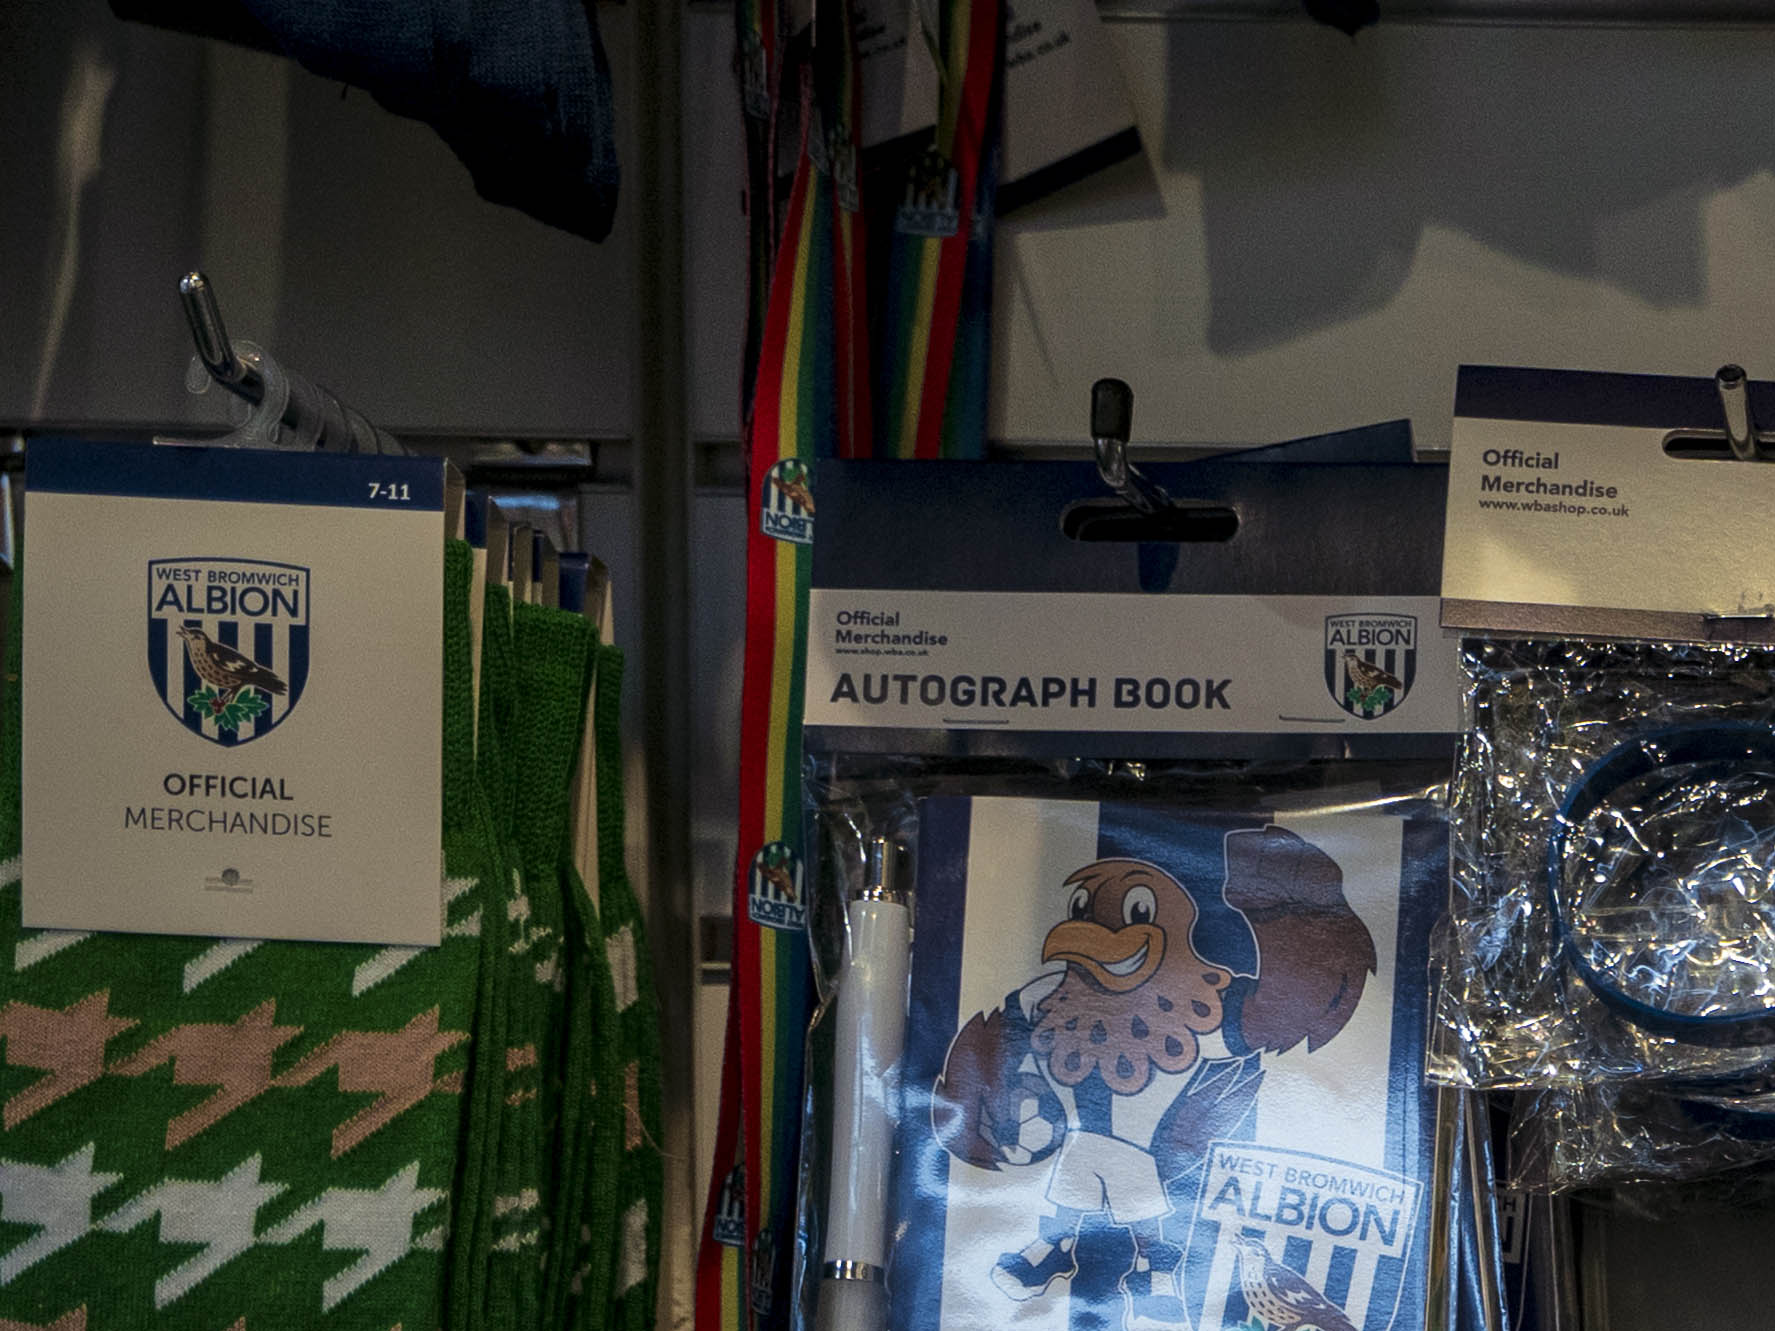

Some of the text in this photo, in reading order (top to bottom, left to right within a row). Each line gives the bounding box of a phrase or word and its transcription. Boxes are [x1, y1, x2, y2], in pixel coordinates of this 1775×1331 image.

[1482, 448, 1559, 470] Official
[368, 482, 411, 501] 7-11
[1480, 474, 1618, 499] Merchandise
[1479, 499, 1630, 518] www.wbashop.co.uk
[156, 567, 300, 586] WEST BROMWICH
[154, 583, 299, 617] ALBION
[836, 610, 900, 628] Official
[835, 629, 948, 646] Merchandise
[1329, 627, 1412, 646] ALBION
[830, 673, 1232, 710] AUTOGRAPH BOOK
[163, 773, 294, 801] OFFICIAL
[124, 807, 332, 837] MERCHANDISE
[1218, 1153, 1407, 1205] WEST BROMWICH
[1207, 1177, 1403, 1247] ALBION
